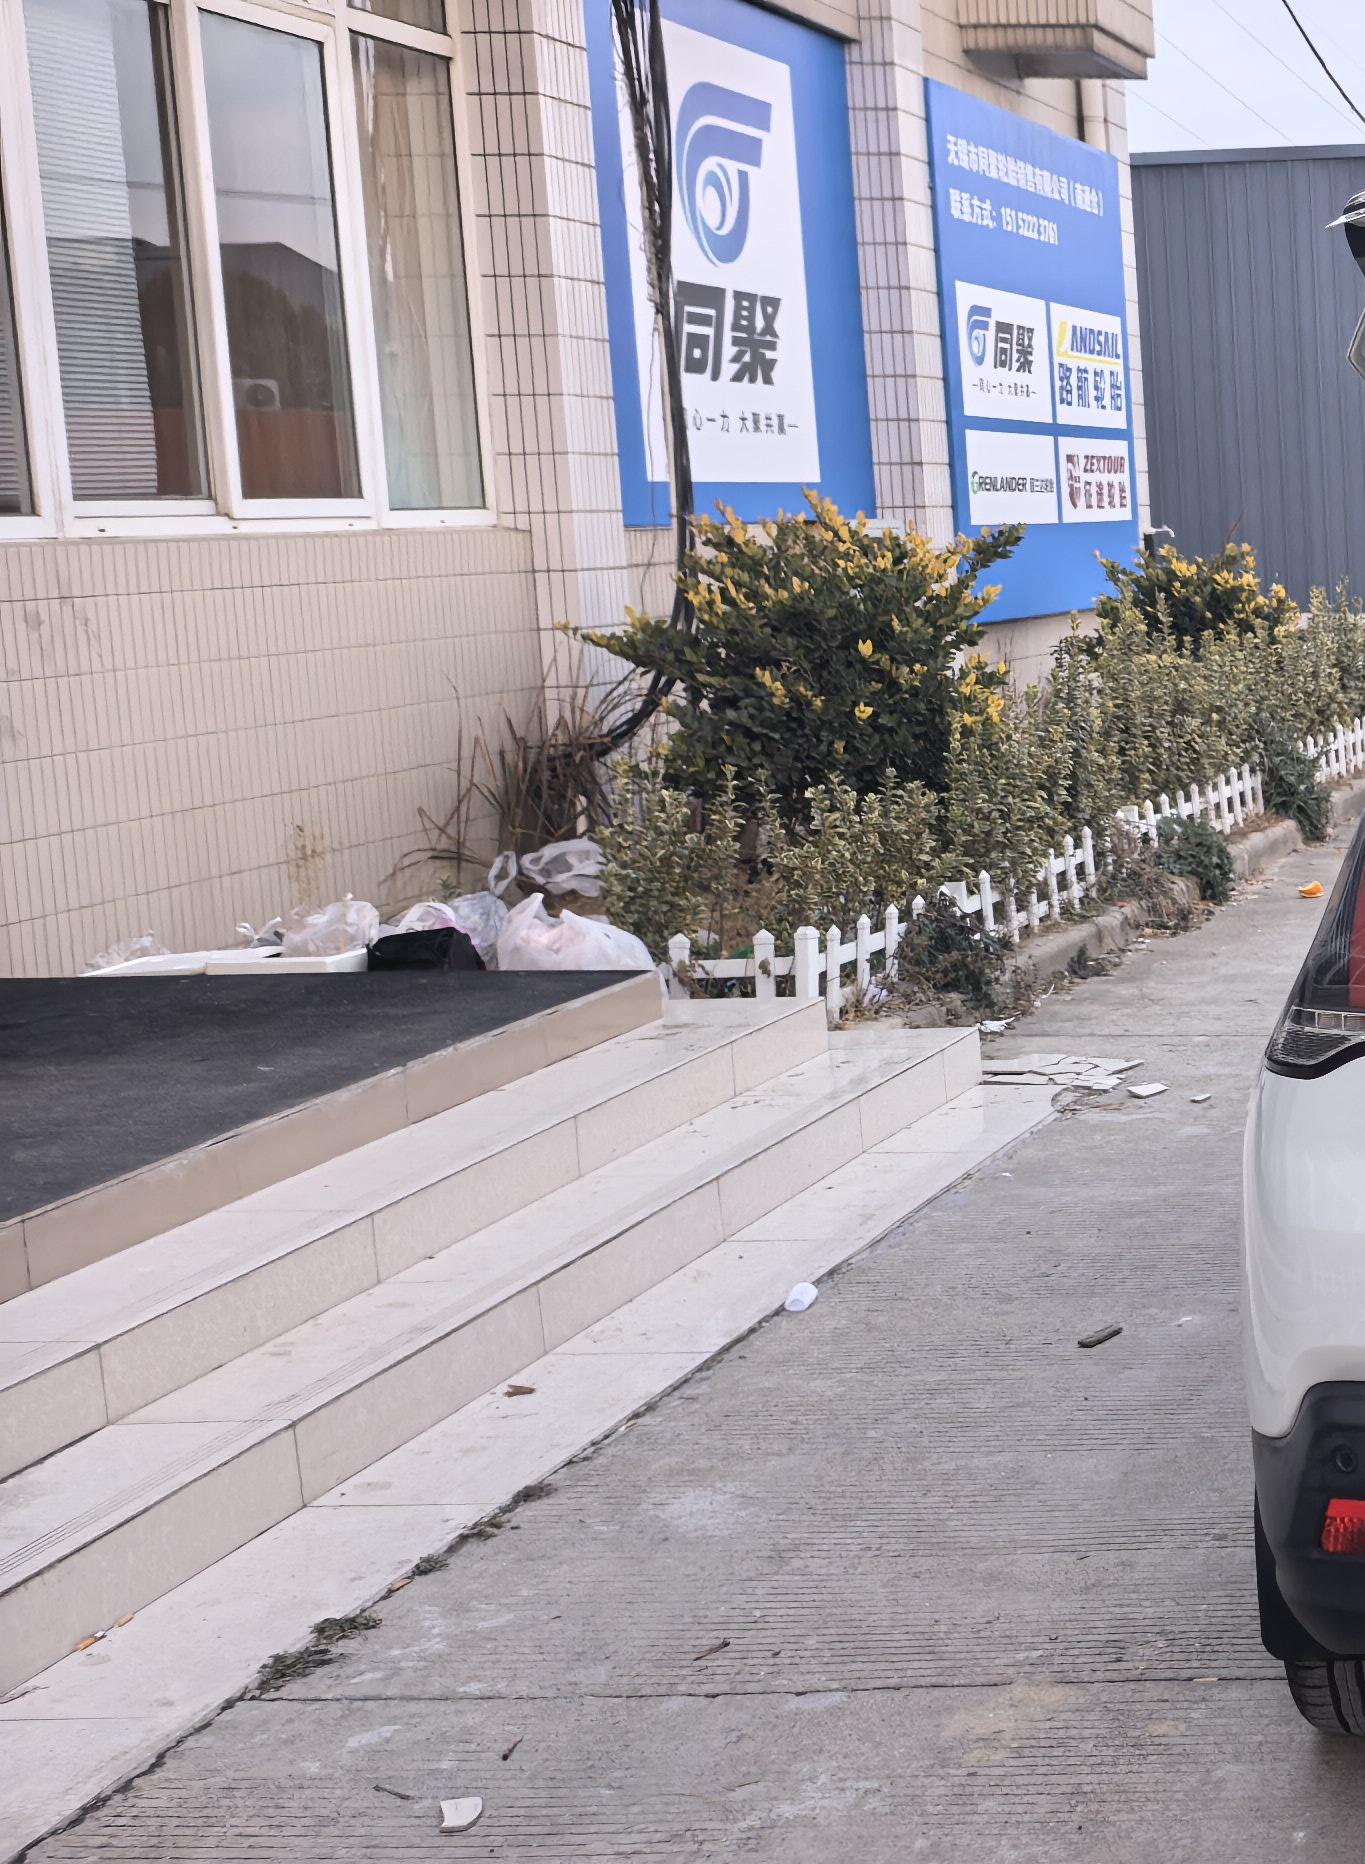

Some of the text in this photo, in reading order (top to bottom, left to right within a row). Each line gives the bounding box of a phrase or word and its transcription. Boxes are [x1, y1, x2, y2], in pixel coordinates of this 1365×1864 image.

[1001, 206, 1017, 234] 151
[674, 280, 781, 386] 同聚
[994, 320, 1035, 375] 同聚
[1056, 320, 1122, 365] LANDSAIL
[1058, 363, 1123, 412] 路航轮胎
[1083, 454, 1126, 474] ZEXTOUR
